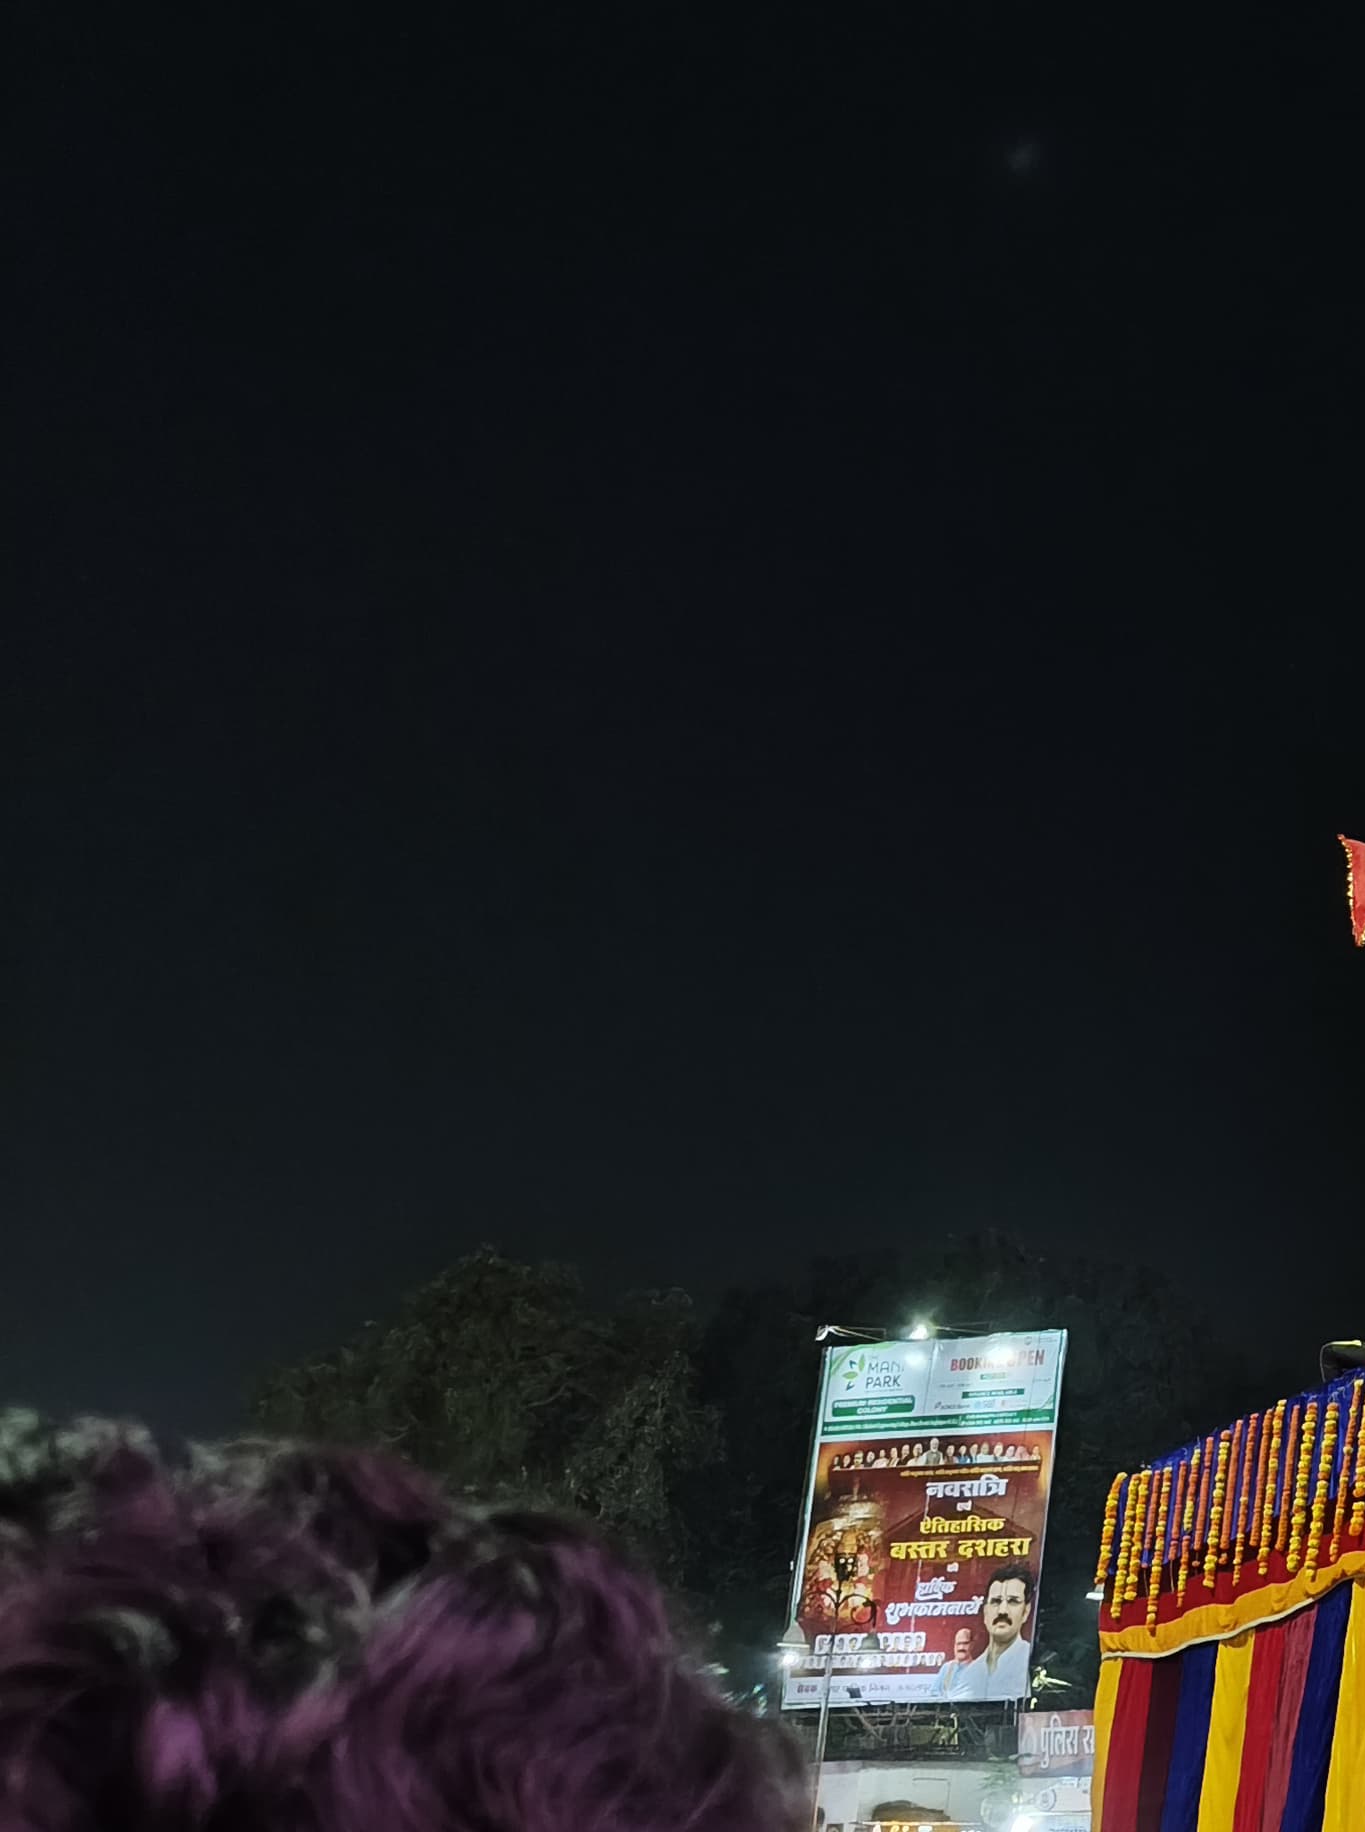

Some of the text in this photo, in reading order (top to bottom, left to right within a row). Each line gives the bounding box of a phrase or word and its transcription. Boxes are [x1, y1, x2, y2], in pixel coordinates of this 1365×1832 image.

[867, 1360, 904, 1374] MAN
[866, 1375, 902, 1389] PARK
[925, 1474, 1009, 1498] नवरात्रि
[919, 1515, 1007, 1535] ऐतिहासिक
[889, 1537, 1033, 1560] बस्तर दशहरा
[1040, 1714, 1080, 1769] पुलिस
